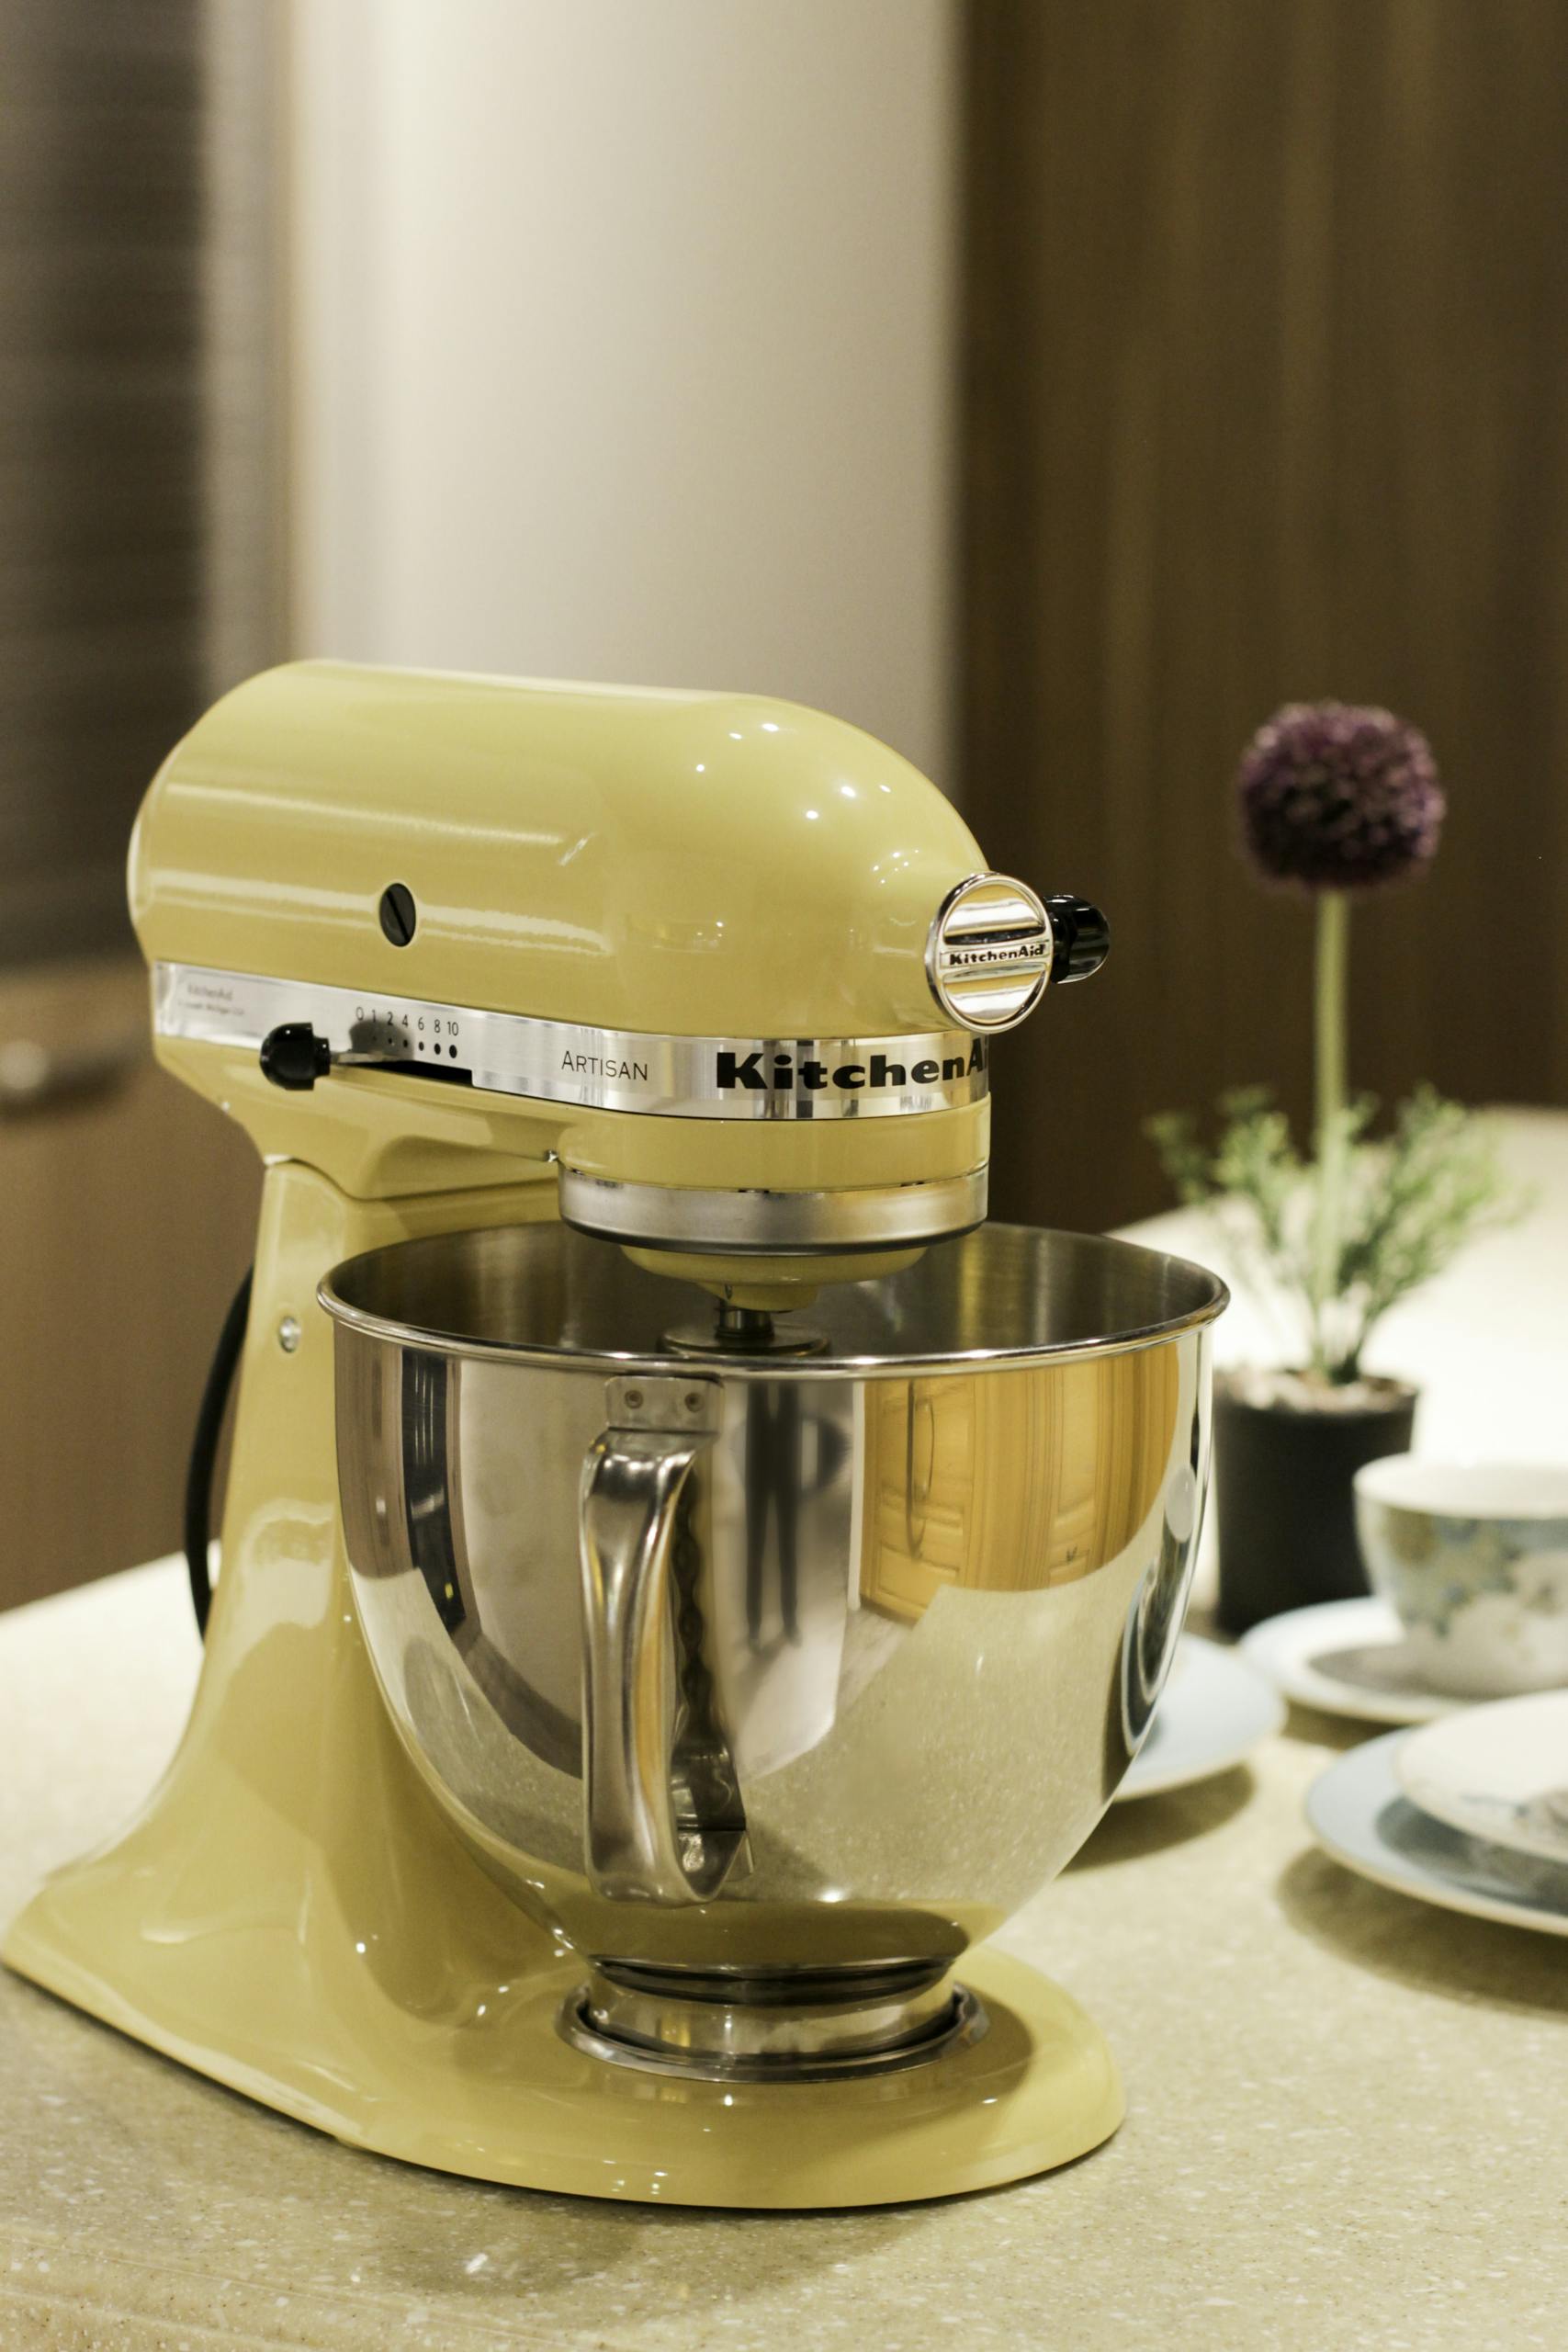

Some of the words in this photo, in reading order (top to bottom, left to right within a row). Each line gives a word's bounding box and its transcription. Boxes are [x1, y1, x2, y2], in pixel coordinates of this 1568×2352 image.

[950, 944, 1046, 966] KitchenAid
[355, 1006, 365, 1021] 0
[371, 1009, 378, 1023] 1
[387, 1012, 394, 1026] 2
[401, 1014, 409, 1027] 4
[418, 1017, 425, 1030] 6
[434, 1019, 441, 1034] 8
[447, 1021, 459, 1036] 10
[561, 1050, 649, 1081] ARTISAN
